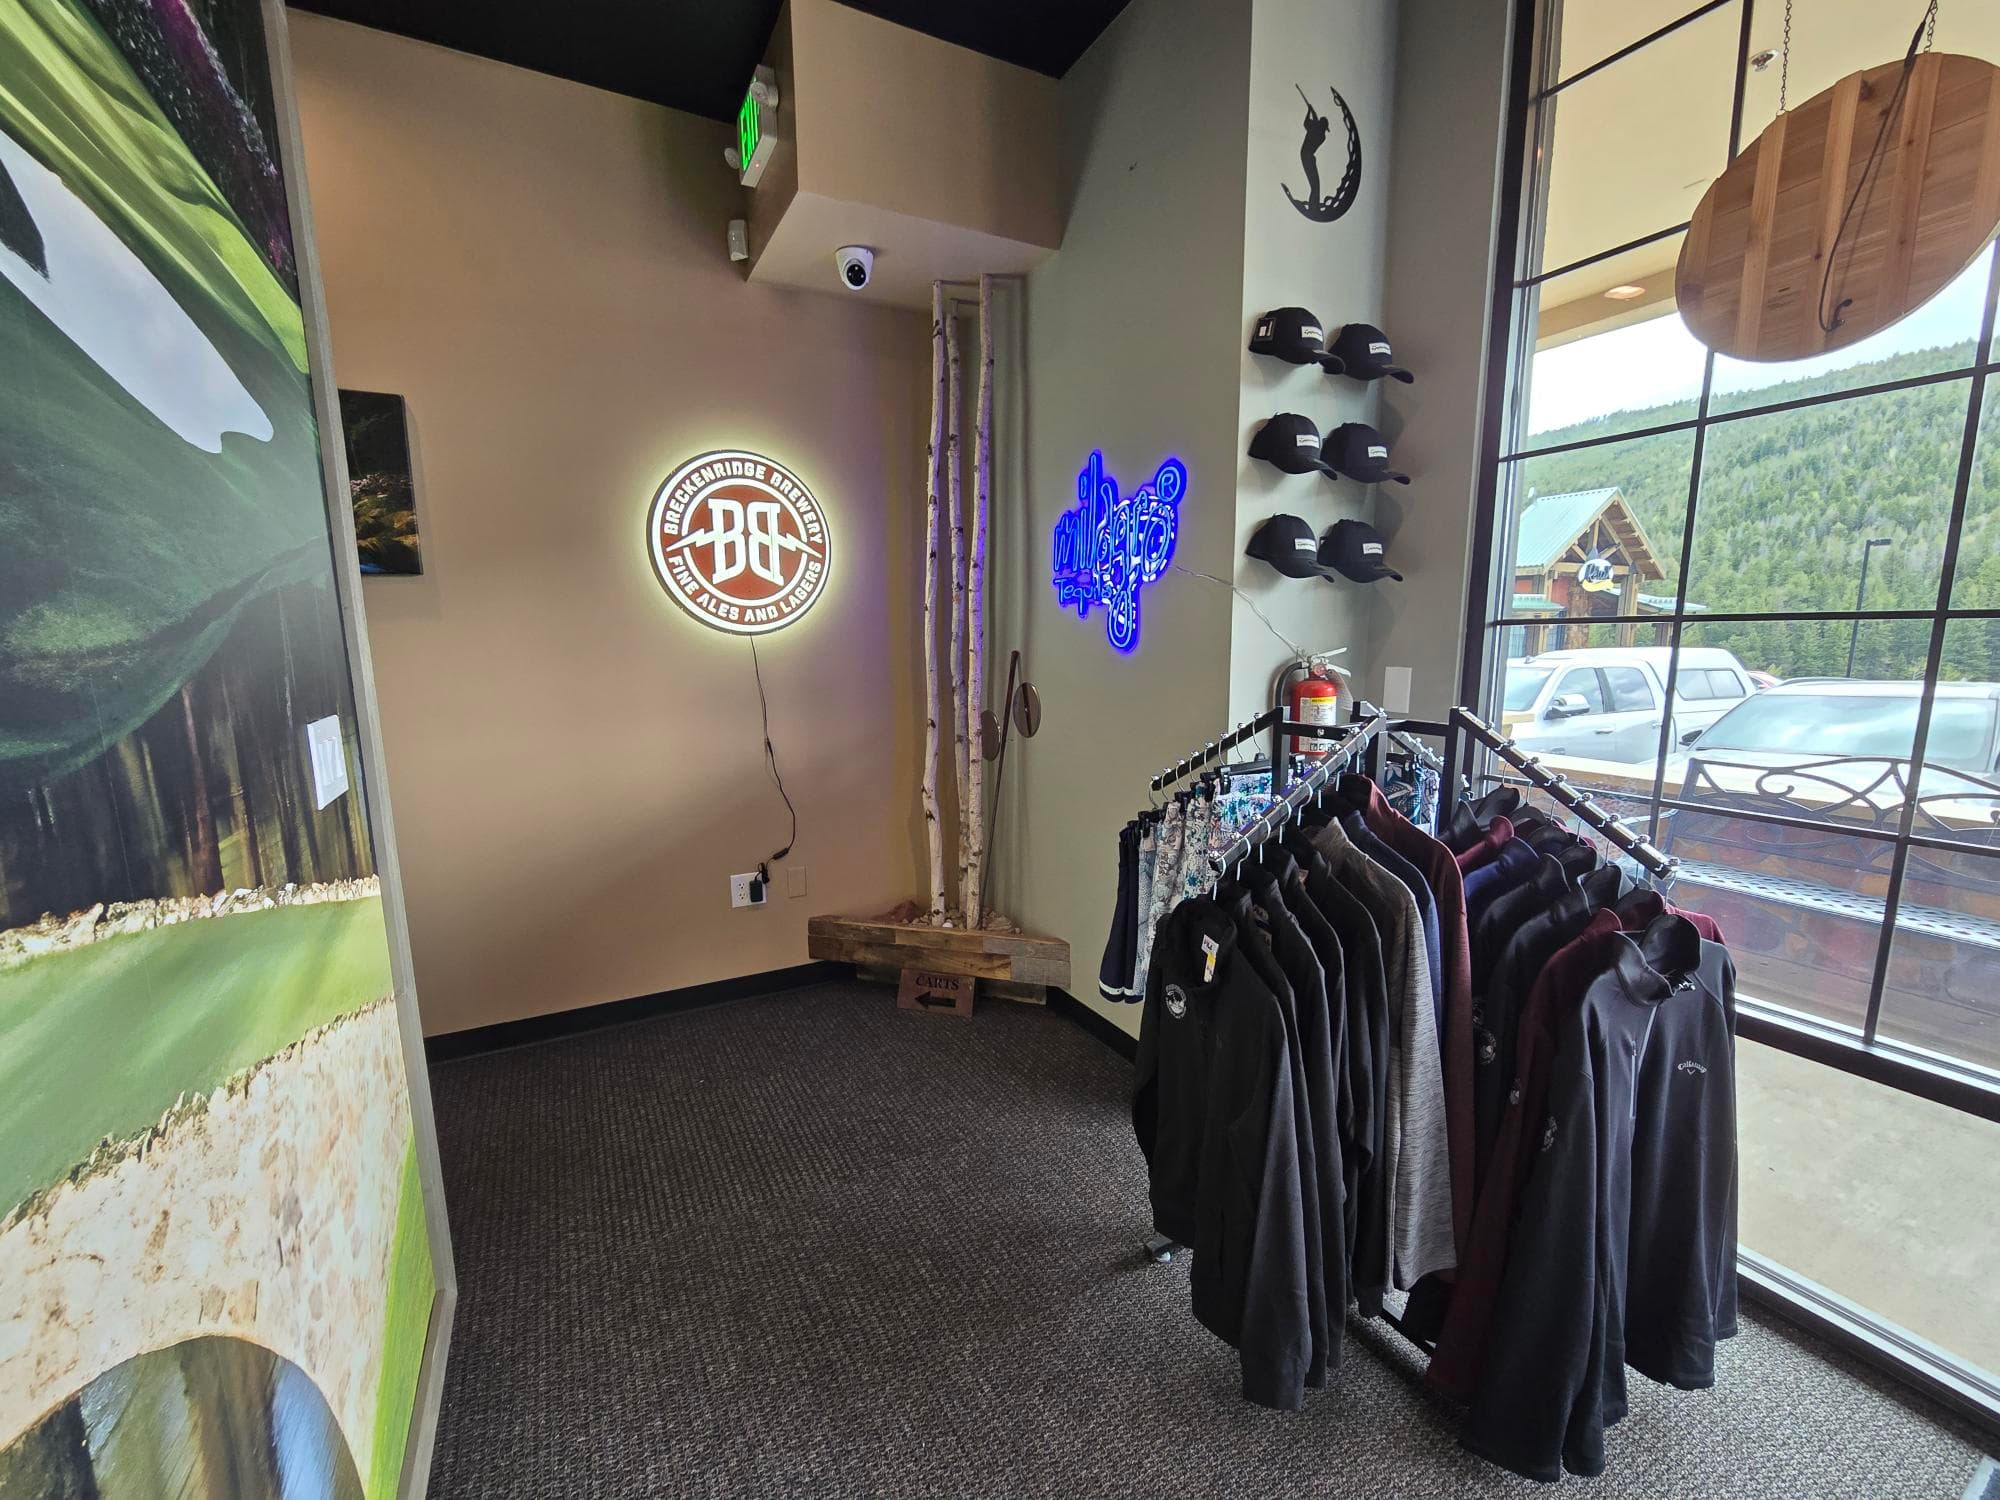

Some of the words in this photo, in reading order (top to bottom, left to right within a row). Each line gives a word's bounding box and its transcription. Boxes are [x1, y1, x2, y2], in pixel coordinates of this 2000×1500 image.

[663, 461, 767, 535] BRECKENRIDGE
[770, 474, 823, 544] BREWERY
[668, 555, 700, 595] FINE
[696, 592, 740, 620] ALES
[744, 606, 778, 623] AND
[780, 561, 822, 614] LAGERS
[915, 975, 960, 991] CARTS
